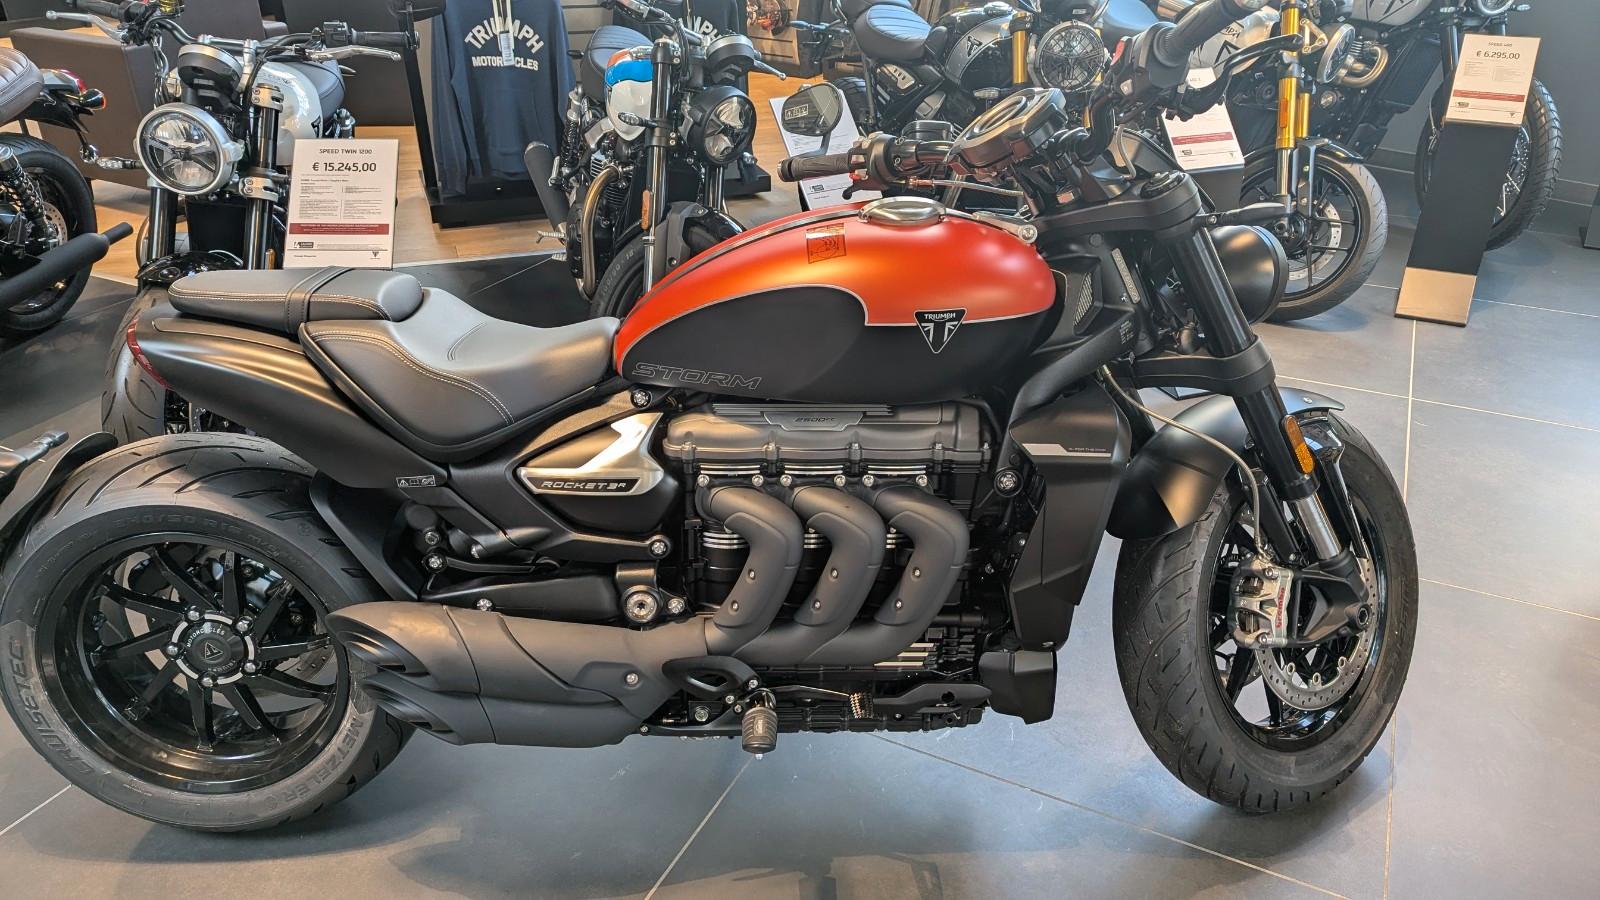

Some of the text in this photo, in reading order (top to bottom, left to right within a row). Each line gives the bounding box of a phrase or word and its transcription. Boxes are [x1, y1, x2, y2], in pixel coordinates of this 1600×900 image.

[1484, 51, 1521, 60] 6.295,00
[472, 56, 539, 71] MOTORCLES
[312, 162, 377, 173] € 15.245,00
[923, 312, 956, 321] TRIUMPH
[631, 362, 762, 390] STORM
